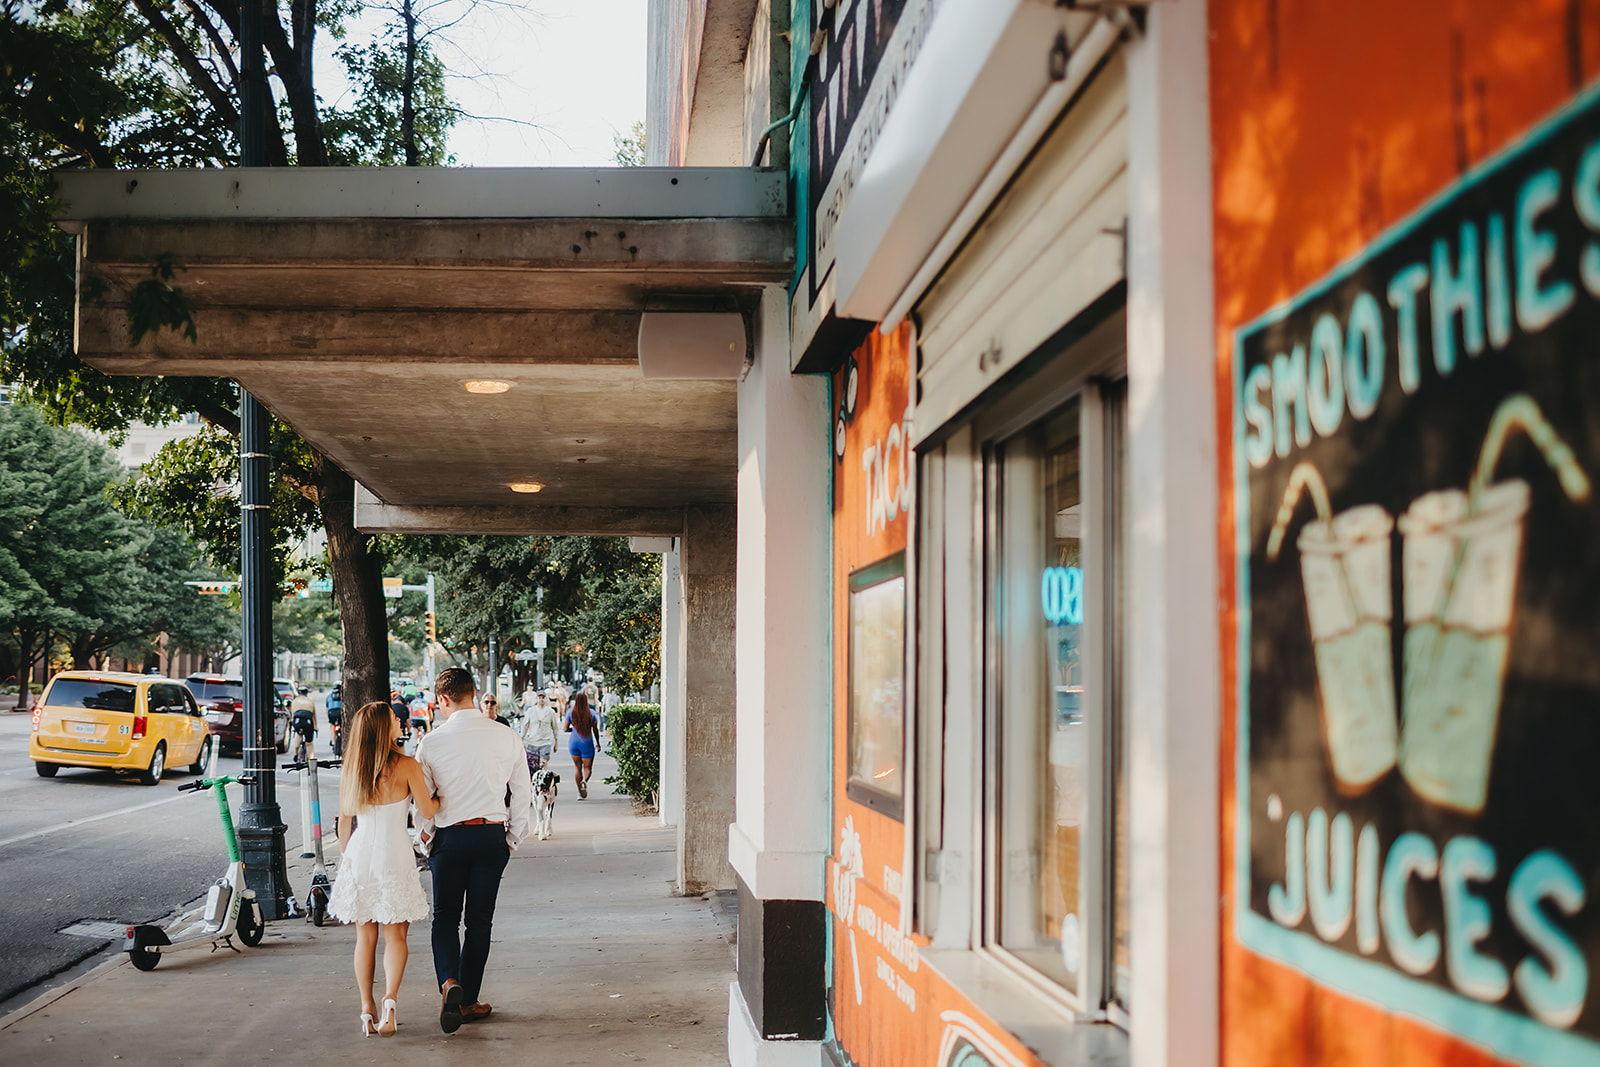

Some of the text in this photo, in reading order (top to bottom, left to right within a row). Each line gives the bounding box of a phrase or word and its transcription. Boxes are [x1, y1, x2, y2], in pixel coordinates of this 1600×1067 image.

[119, 725, 129, 734] 91
[230, 890, 241, 921] Lime
[1268, 806, 1588, 1029] JUICES
